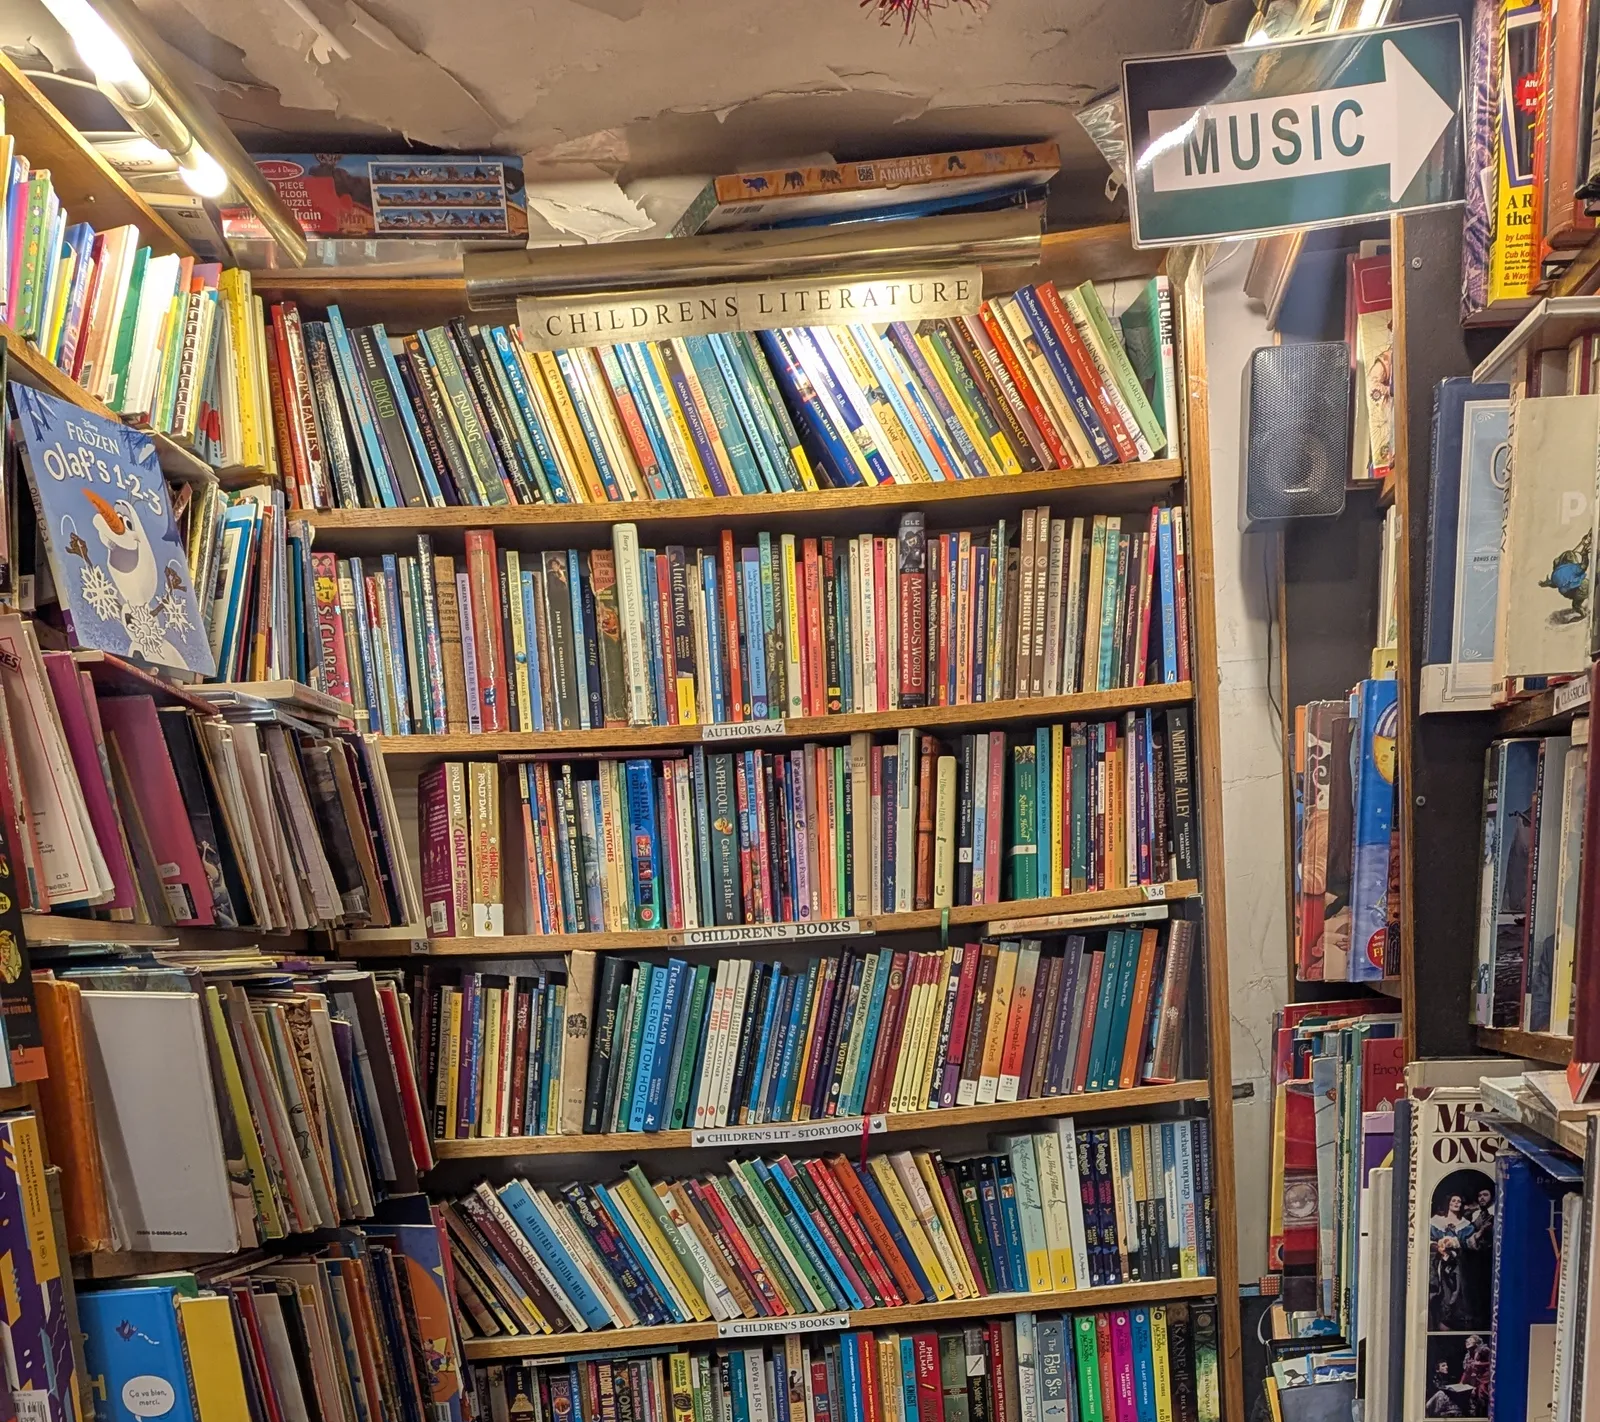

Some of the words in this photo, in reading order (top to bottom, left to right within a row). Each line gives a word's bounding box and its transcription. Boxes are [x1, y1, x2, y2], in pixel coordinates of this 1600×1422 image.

[1183, 98, 1366, 177] MUSIC
[880, 165, 932, 180] ANIMALS
[294, 209, 321, 220] Train
[545, 297, 739, 337] CHILDRENS
[757, 280, 971, 314] LITERATURE
[1157, 291, 1172, 345] BLUME
[361, 335, 376, 368] ALEXANDER
[508, 365, 524, 394] FLINT
[548, 368, 567, 407] CRISPIN
[1108, 334, 1118, 349] THE
[1114, 348, 1132, 381] SECRET
[1127, 381, 1146, 409] GARDEN
[371, 378, 395, 418] BOOKED
[1076, 396, 1090, 418] Bauer
[65, 420, 120, 456] FROZEN
[82, 418, 99, 432] Disney
[878, 411, 889, 425] Cry
[886, 426, 899, 442] Wolf
[43, 443, 110, 484] Olaf's
[115, 464, 162, 516] 1-2-3
[625, 568, 635, 622] THOUSAND
[630, 623, 638, 650] NEVER
[911, 578, 921, 645] MARVELOUS
[911, 646, 921, 687] WORLD
[707, 726, 761, 738] AUTHORS
[764, 723, 783, 733] A-Z
[1172, 729, 1187, 783] NIGHTMARE
[452, 766, 460, 792] ROALD
[715, 758, 727, 814] SAPPHIQUE
[453, 795, 461, 817] DAHL
[604, 811, 612, 824] THE
[639, 781, 651, 821] STORY
[1174, 786, 1190, 823] ALLEY
[605, 827, 614, 863] WITCHES
[721, 839, 730, 876] Catherine
[723, 879, 732, 908] Fisher
[1151, 888, 1163, 896] 3.6
[415, 942, 428, 951] 3.5
[691, 928, 786, 943] CHILDREN'S
[796, 920, 851, 935] BOOKS
[665, 965, 681, 1011] TREASURE
[862, 958, 875, 992] RUDYARD
[649, 970, 664, 1038] CHALLENGE
[854, 994, 865, 1027] KIPLING
[659, 1013, 672, 1045] ISLAND
[994, 1013, 1002, 1034] Many
[643, 1044, 653, 1067] TOM
[835, 1042, 848, 1075] WORTH
[989, 1036, 998, 1062] Waters
[637, 1070, 650, 1113] HOYLE
[708, 1131, 771, 1143] CHILDREN'S
[774, 1131, 790, 1139] LIT
[1180, 1126, 1189, 1161] michael
[1181, 1163, 1190, 1199] morpurgo
[1187, 1202, 1196, 1253] PINOCCHIO
[480, 1189, 503, 1219] BLOOD
[502, 1217, 518, 1239] RED
[514, 1237, 540, 1269] OCHRE
[537, 1267, 551, 1284] Kevin
[547, 1282, 563, 1302] Major
[733, 1322, 797, 1333] CHILDREN'S
[800, 1318, 835, 1328] BOOKS
[678, 1359, 686, 1386] JAMES
[919, 1341, 927, 1377] PULLMAN
[925, 1347, 934, 1370] PHILIP
[1044, 1354, 1060, 1375] Big
[599, 1365, 614, 1395] WELCOME
[906, 1385, 916, 1408] KNIGHT
[1045, 1378, 1062, 1397] Six
